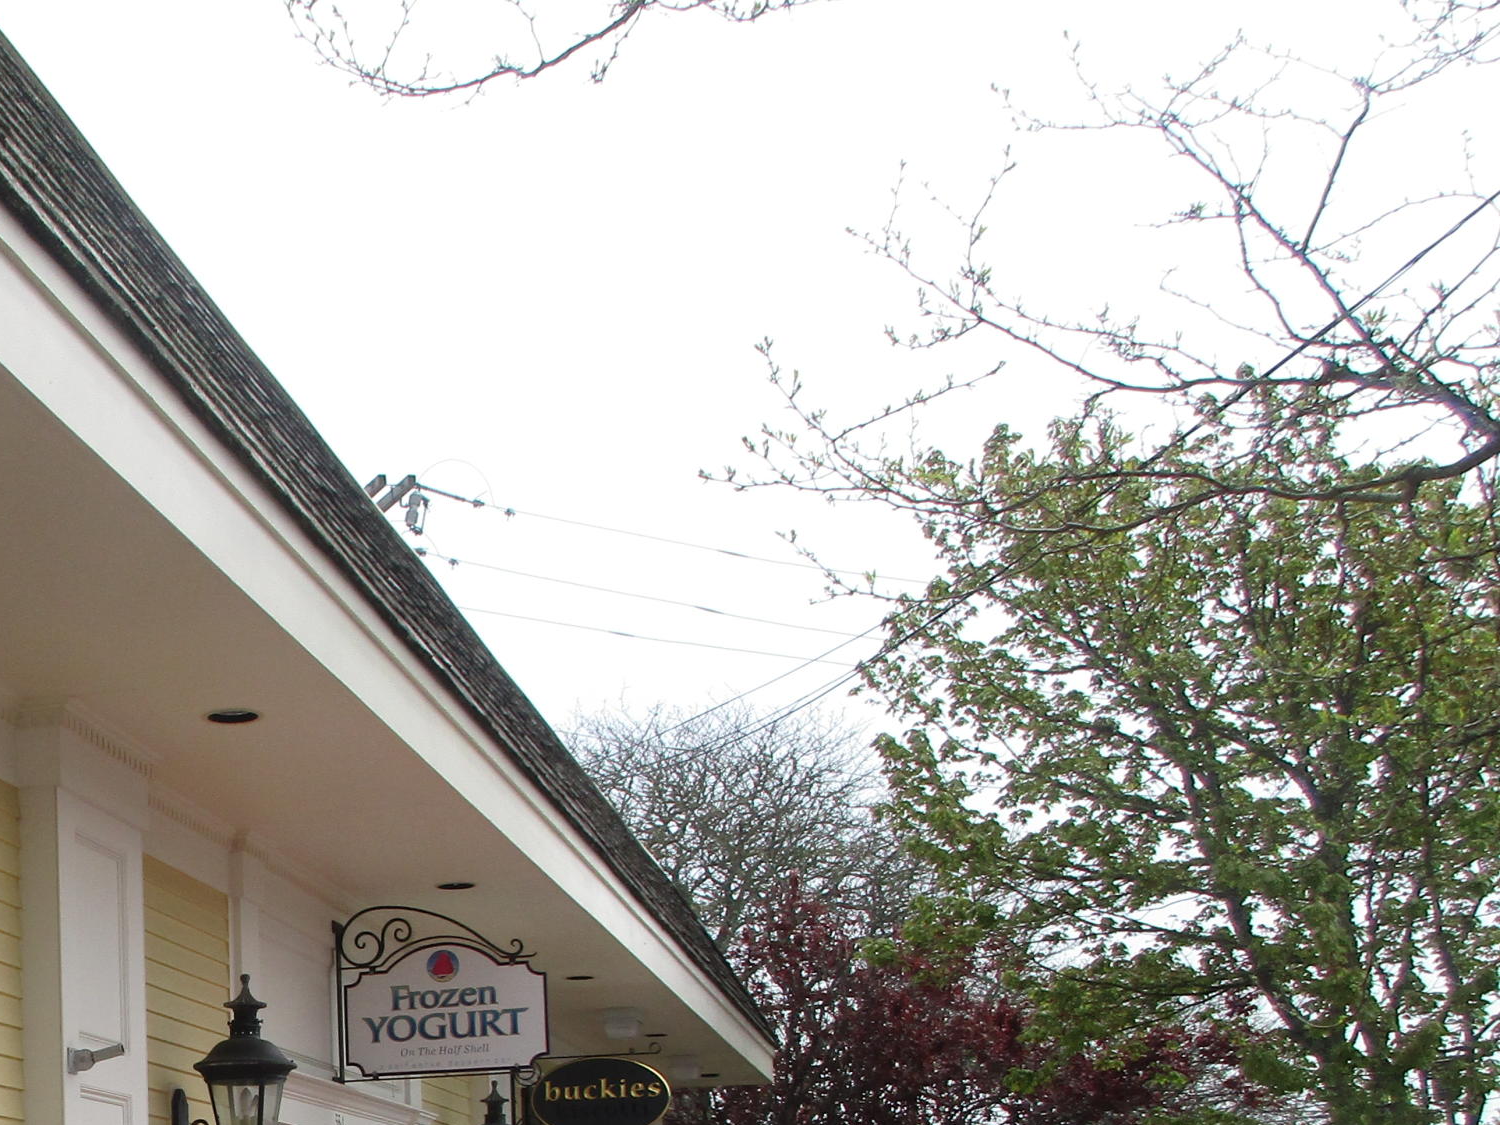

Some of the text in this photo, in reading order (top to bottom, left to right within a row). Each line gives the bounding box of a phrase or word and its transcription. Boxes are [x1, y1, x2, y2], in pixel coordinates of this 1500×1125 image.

[389, 984, 499, 1011] Frozen
[362, 1007, 529, 1043] YOGURT
[400, 1043, 489, 1057] On The Half Shell
[544, 1078, 661, 1101] buckies
